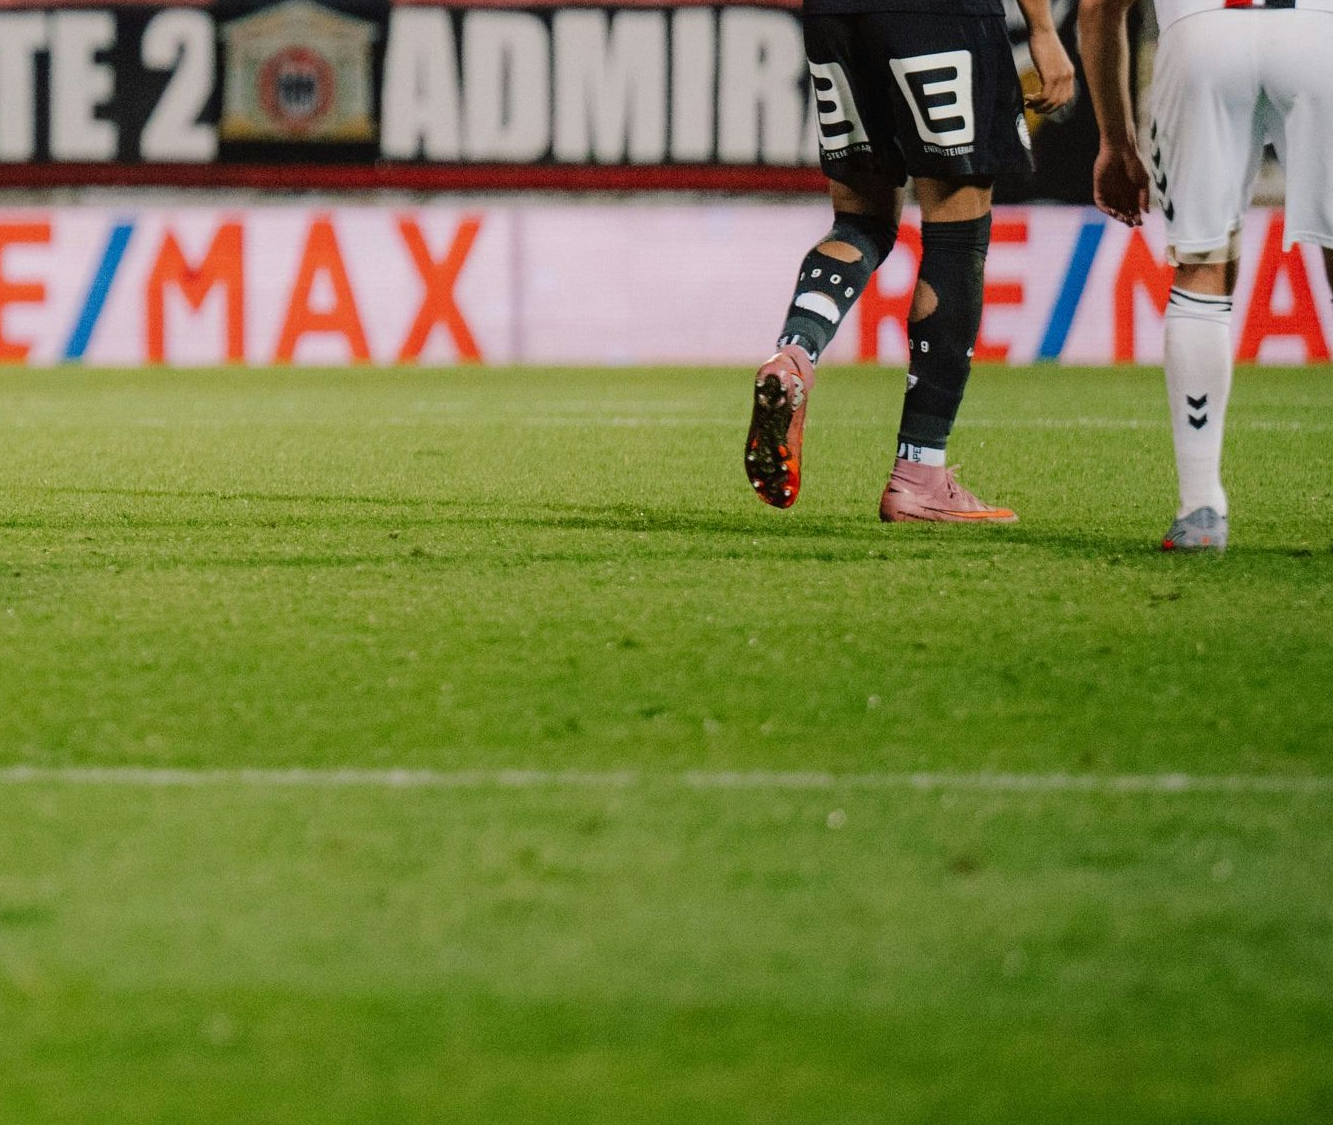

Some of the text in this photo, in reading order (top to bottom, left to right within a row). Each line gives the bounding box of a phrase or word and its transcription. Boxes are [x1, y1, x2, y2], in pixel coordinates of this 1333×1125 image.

[141, 7, 216, 162] 2
[379, 8, 823, 165] ADMIR
[800, 268, 854, 299] 1909
